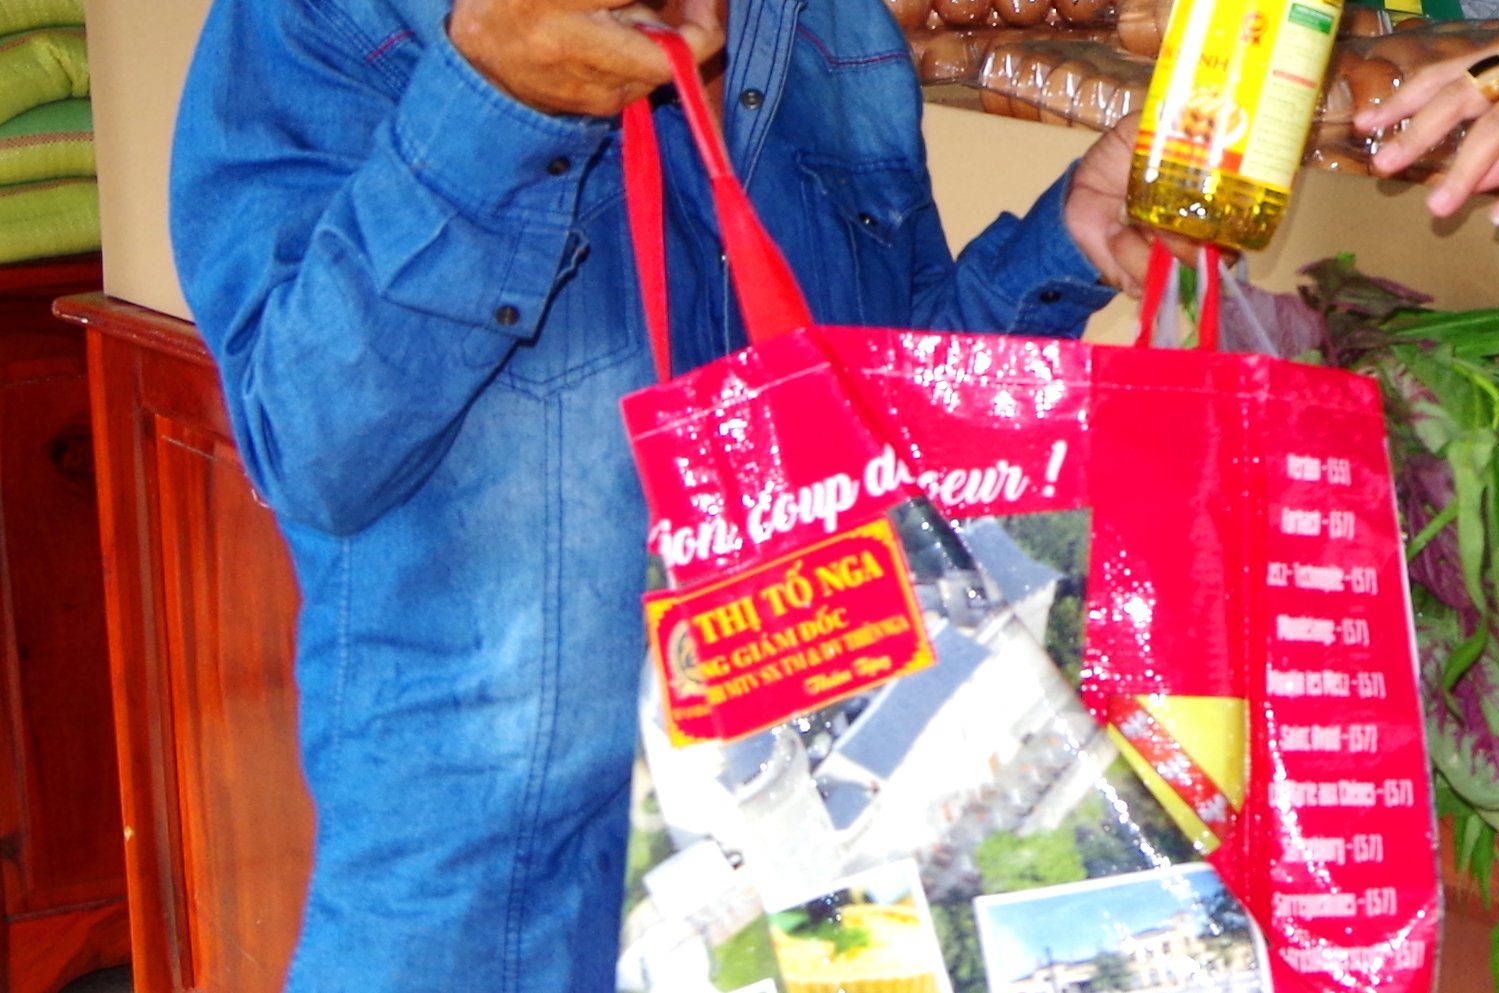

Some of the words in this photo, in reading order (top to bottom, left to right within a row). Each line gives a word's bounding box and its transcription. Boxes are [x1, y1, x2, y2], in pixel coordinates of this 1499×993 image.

[747, 472, 860, 544] coup
[1329, 511, 1355, 541] (57)
[1351, 566, 1378, 596] (57)
[694, 594, 763, 645] THỊ
[814, 550, 885, 596] NGA
[1342, 617, 1370, 647] (57)
[731, 628, 798, 669] GIÁM
[1358, 671, 1386, 699] (57)
[1349, 724, 1378, 753] (57)
[1384, 778, 1414, 807] (57)
[1353, 833, 1383, 863] (57)
[1365, 886, 1397, 917] (57)
